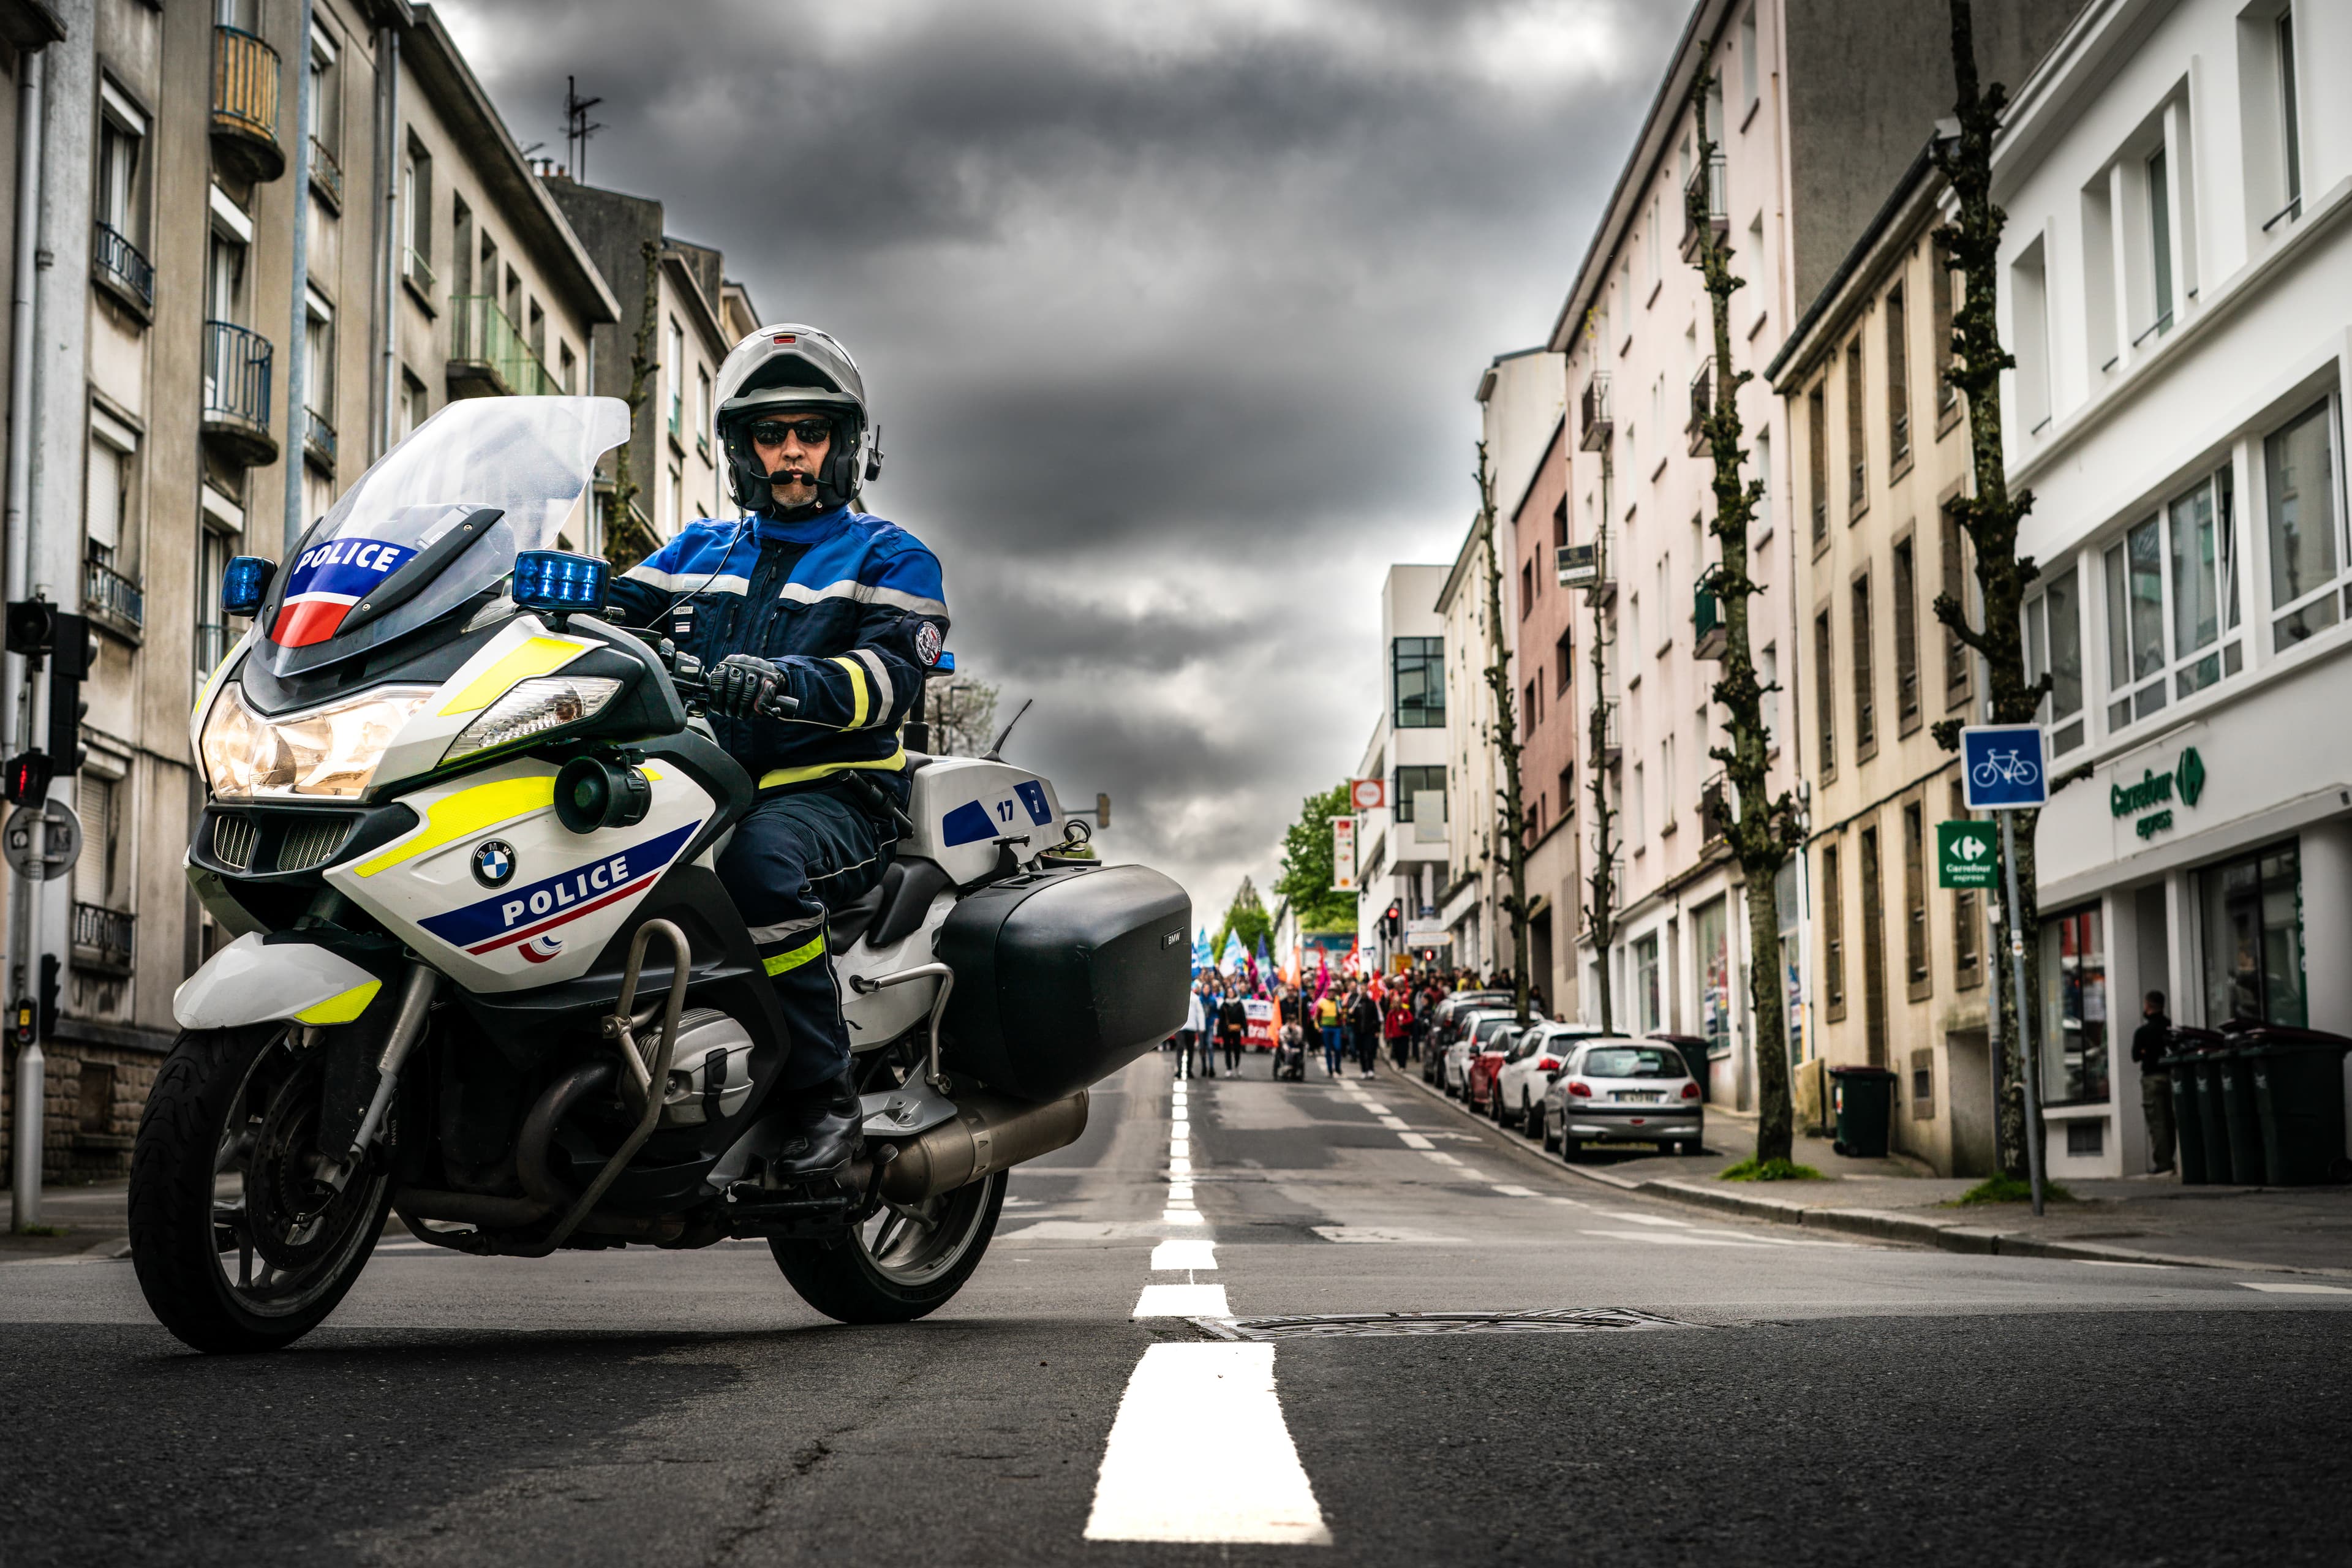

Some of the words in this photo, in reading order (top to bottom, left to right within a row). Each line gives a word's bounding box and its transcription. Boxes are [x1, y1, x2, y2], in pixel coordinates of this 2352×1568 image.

[293, 542, 401, 575] POLICE
[2111, 768, 2173, 820] Carrefour
[997, 799, 1014, 822] 17
[2136, 809, 2173, 840] express
[477, 842, 511, 859] BMW
[1946, 862, 1991, 873] Carrefour
[1952, 875, 1986, 883] express
[502, 856, 629, 927] POLICE
[1168, 932, 1180, 945] BMW
